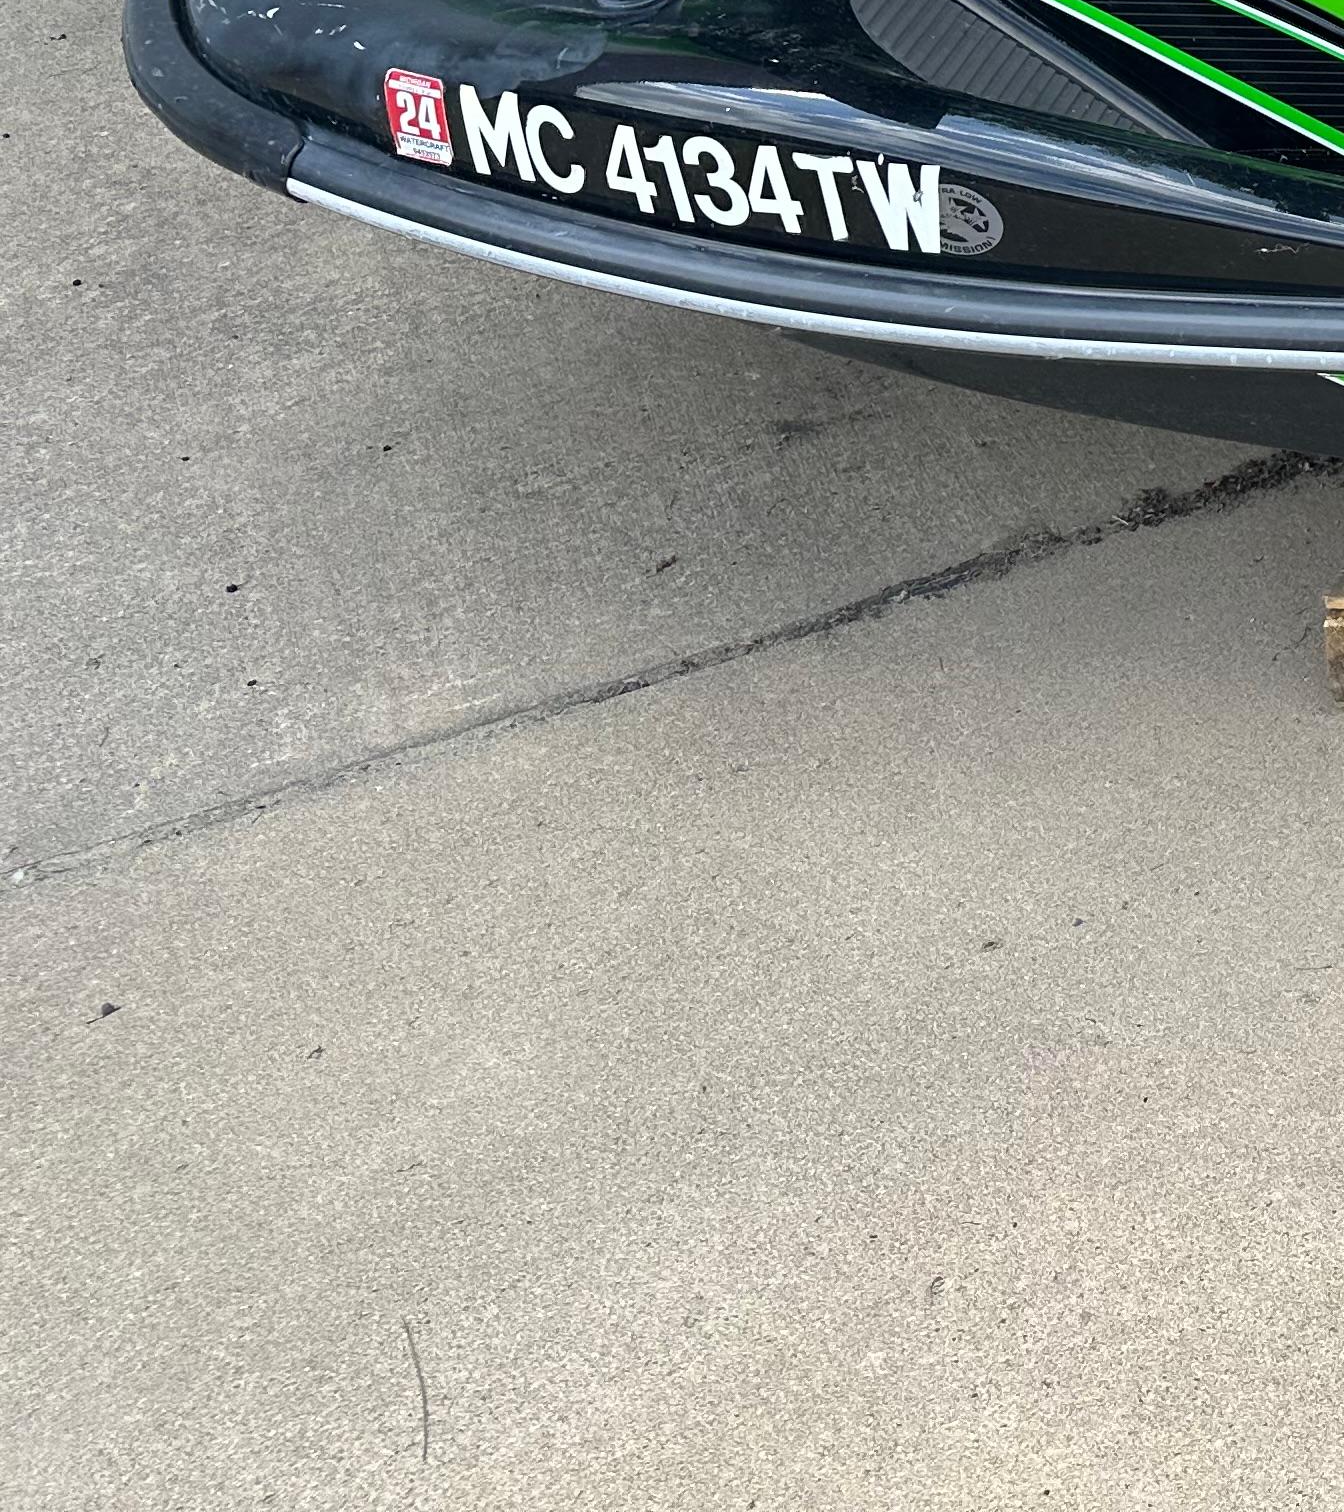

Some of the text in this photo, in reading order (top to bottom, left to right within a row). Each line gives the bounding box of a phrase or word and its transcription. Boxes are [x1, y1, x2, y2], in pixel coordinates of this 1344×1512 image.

[396, 90, 441, 141] 24
[459, 84, 941, 254] MC 4134TW
[940, 238, 993, 254] MISSION
